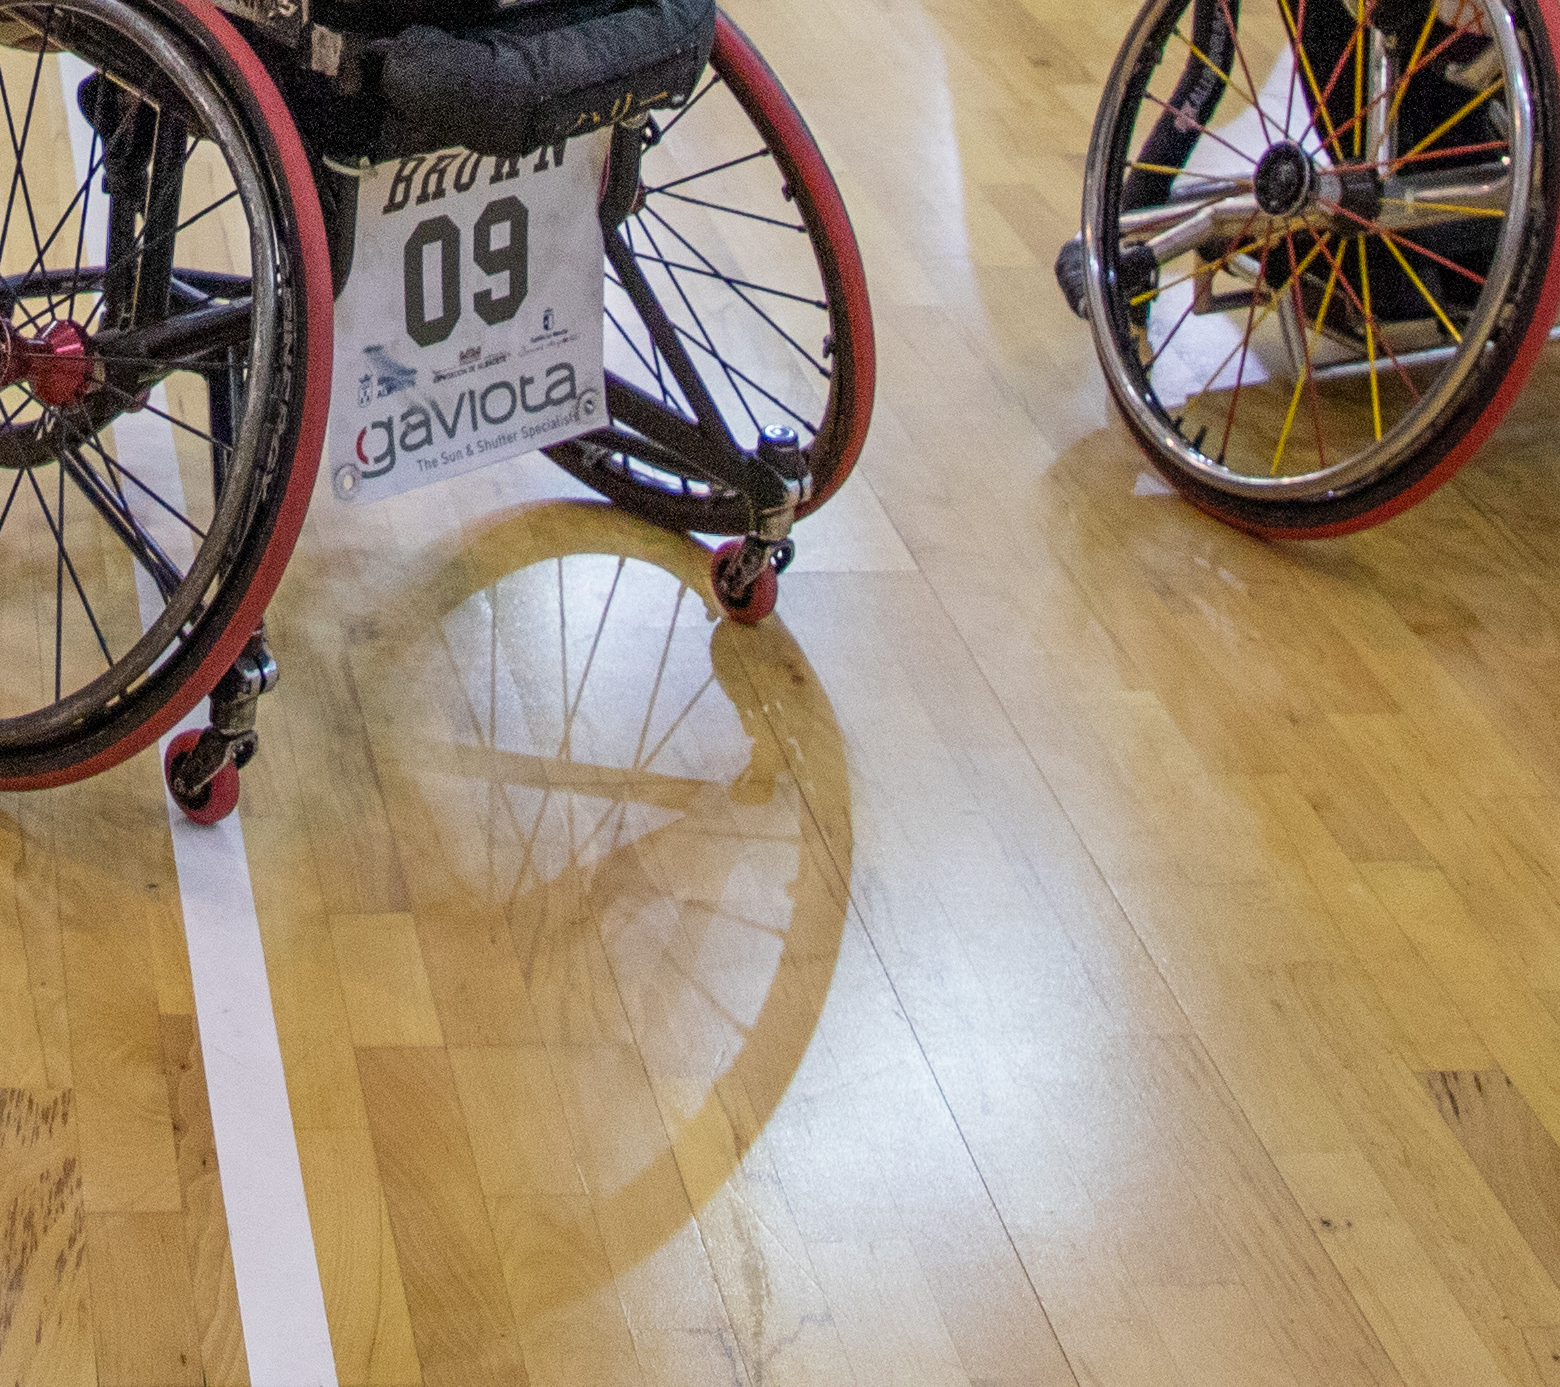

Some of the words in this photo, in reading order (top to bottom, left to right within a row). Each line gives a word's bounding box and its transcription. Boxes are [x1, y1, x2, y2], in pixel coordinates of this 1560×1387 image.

[403, 194, 529, 349] 09
[355, 362, 578, 478] gaviota
[417, 454, 438, 472] The
[440, 449, 463, 465] Sun
[478, 430, 518, 453] Shutter
